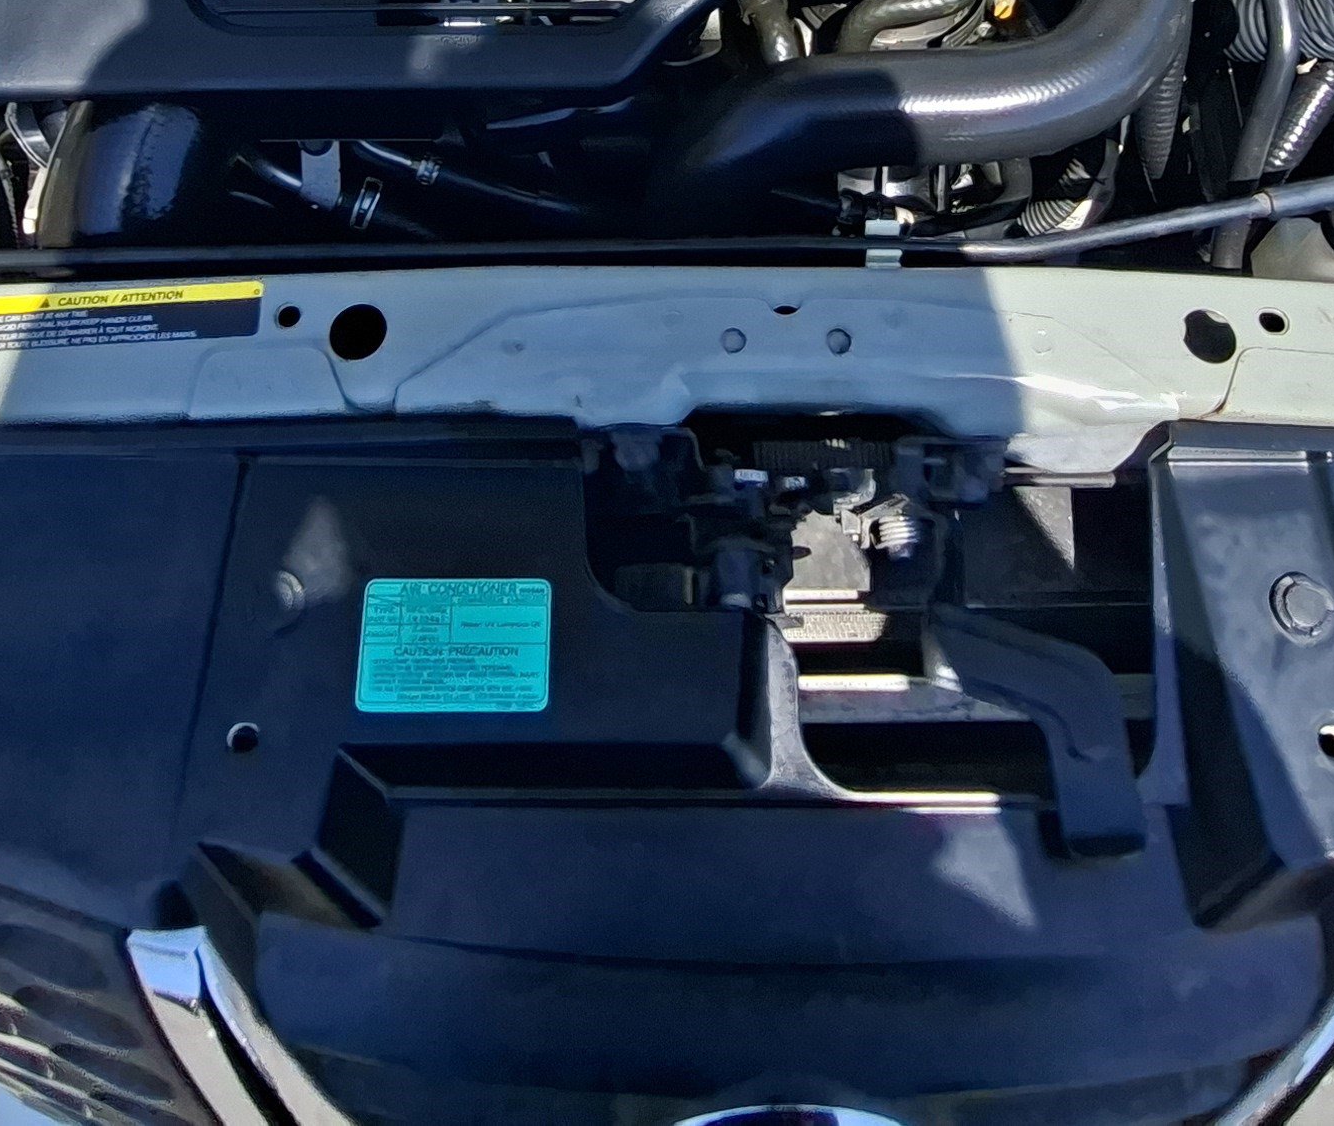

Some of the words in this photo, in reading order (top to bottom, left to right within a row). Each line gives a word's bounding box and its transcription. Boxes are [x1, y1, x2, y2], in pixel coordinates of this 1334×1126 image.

[58, 295, 109, 307] CAUTION
[120, 290, 185, 303] ATTENTION
[428, 582, 517, 595] CONDITIONER
[394, 647, 443, 657] CAUTION
[448, 646, 520, 657] PRÉCAUTION
